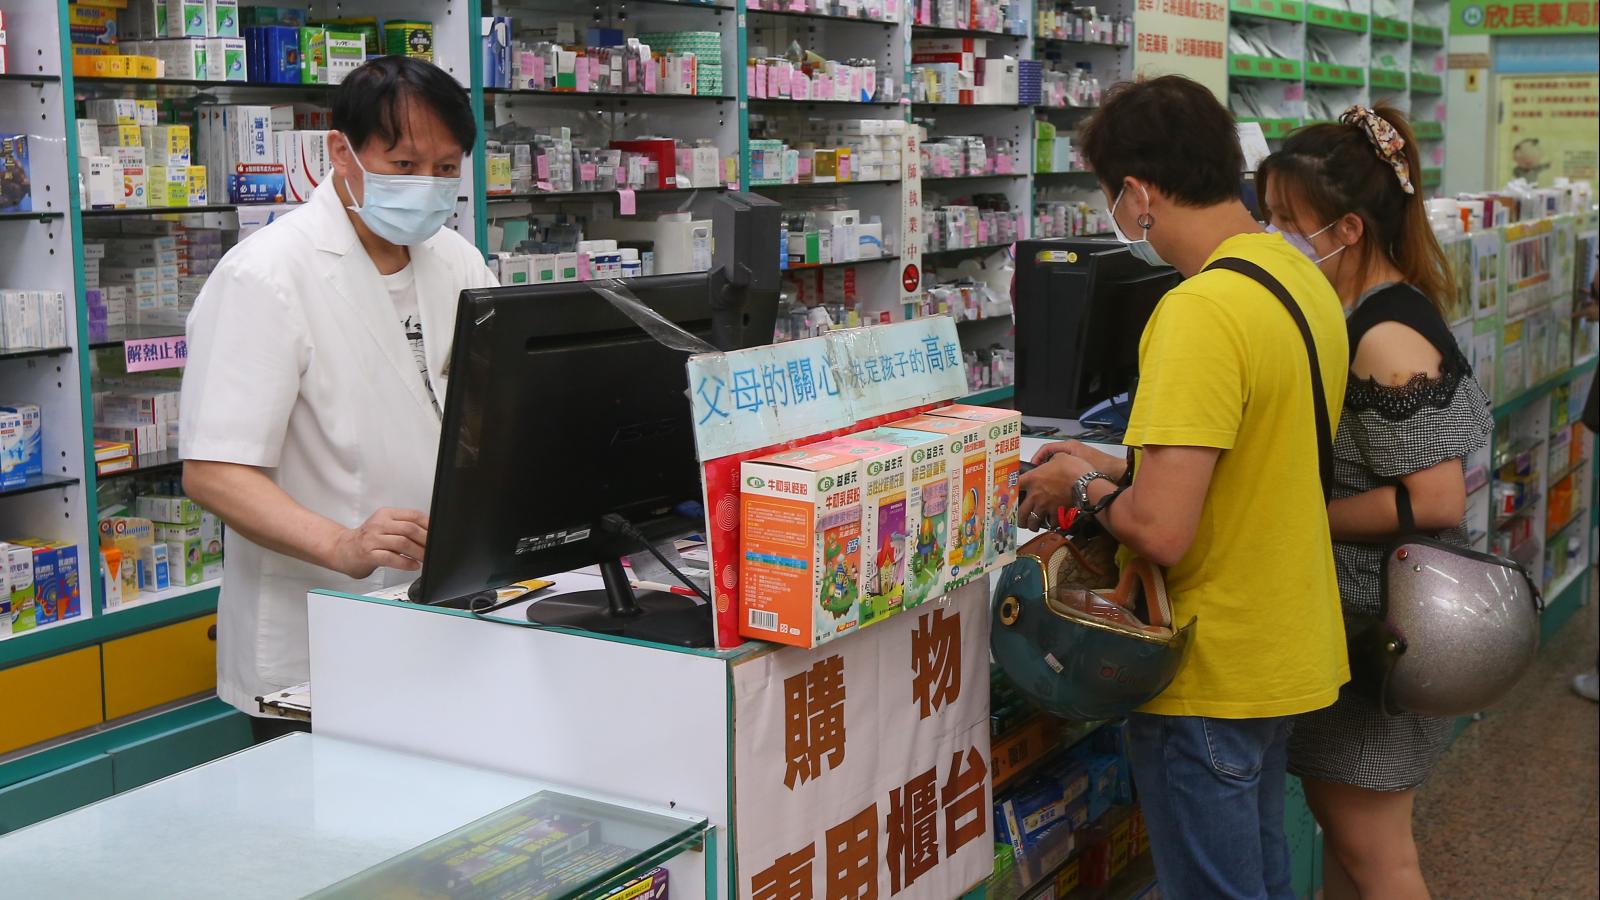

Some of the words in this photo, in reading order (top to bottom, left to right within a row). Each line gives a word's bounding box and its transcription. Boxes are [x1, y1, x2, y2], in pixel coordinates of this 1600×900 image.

[1484, 1, 1599, 28] 欣民藥局
[906, 136, 919, 259] 藥師執業中
[127, 340, 187, 363] 解熱止痛
[696, 355, 841, 426] 父母的關心
[851, 334, 960, 389] 決定孩子的高度
